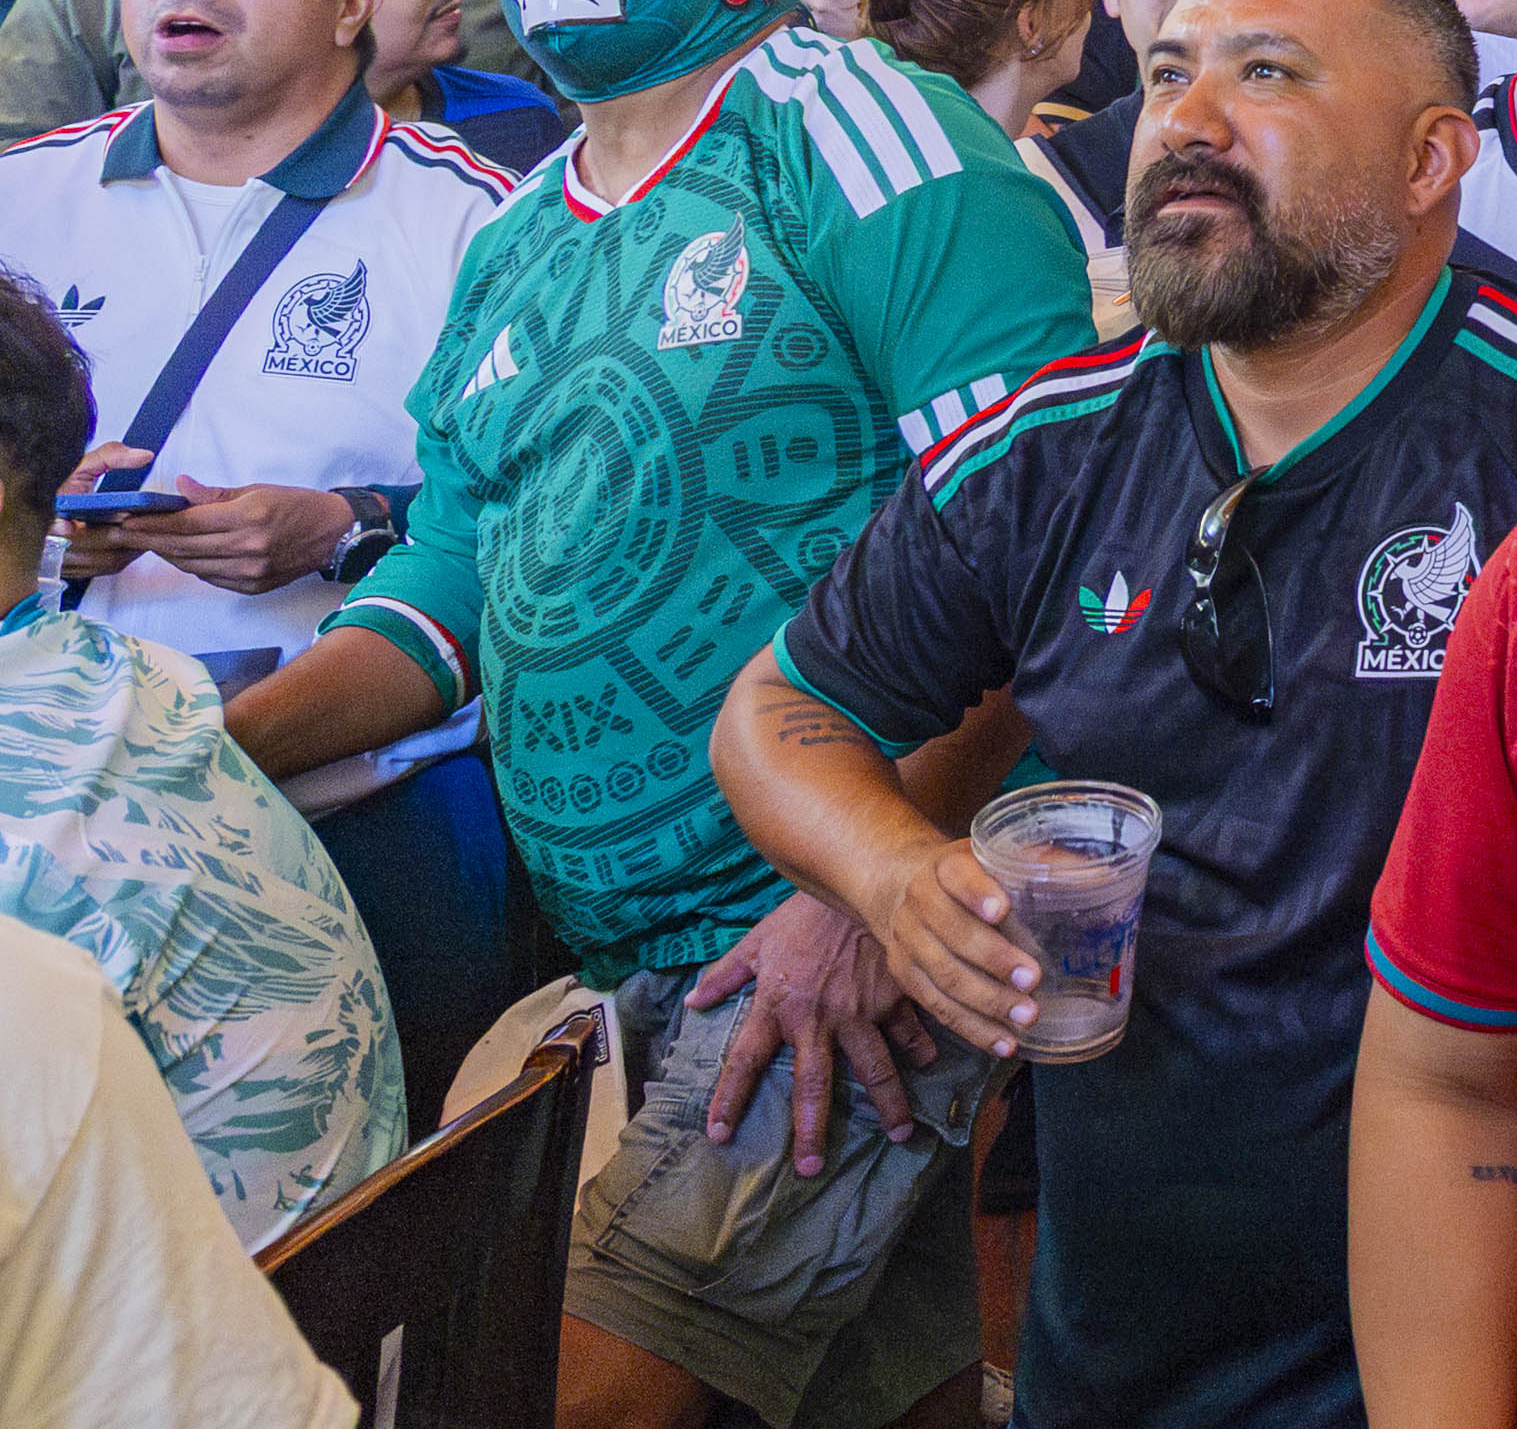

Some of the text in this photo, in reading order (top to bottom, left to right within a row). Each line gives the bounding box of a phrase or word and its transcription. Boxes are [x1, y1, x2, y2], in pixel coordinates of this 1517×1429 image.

[660, 319, 738, 346] MÉXICO
[268, 353, 350, 376] MÉXICO
[1363, 644, 1446, 670] MÉXIC
